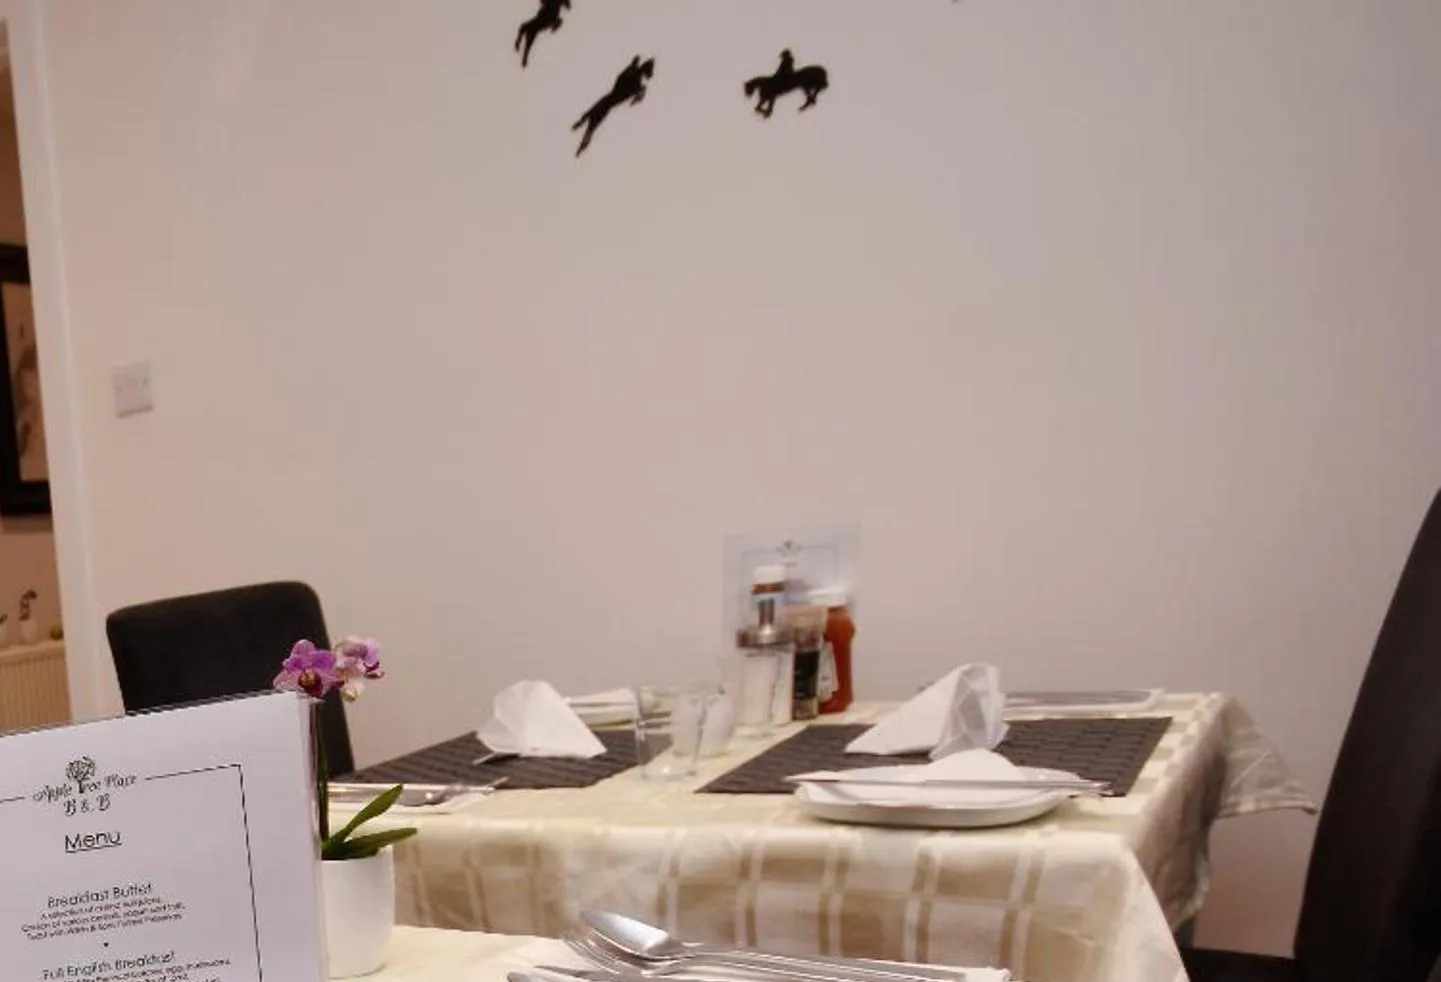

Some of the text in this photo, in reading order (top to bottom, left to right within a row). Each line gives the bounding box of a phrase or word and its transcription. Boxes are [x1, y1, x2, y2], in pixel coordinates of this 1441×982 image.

[64, 831, 122, 851] Menu
[47, 888, 110, 909] Breakfast
[112, 882, 153, 899] Buffet
[66, 959, 113, 978] English
